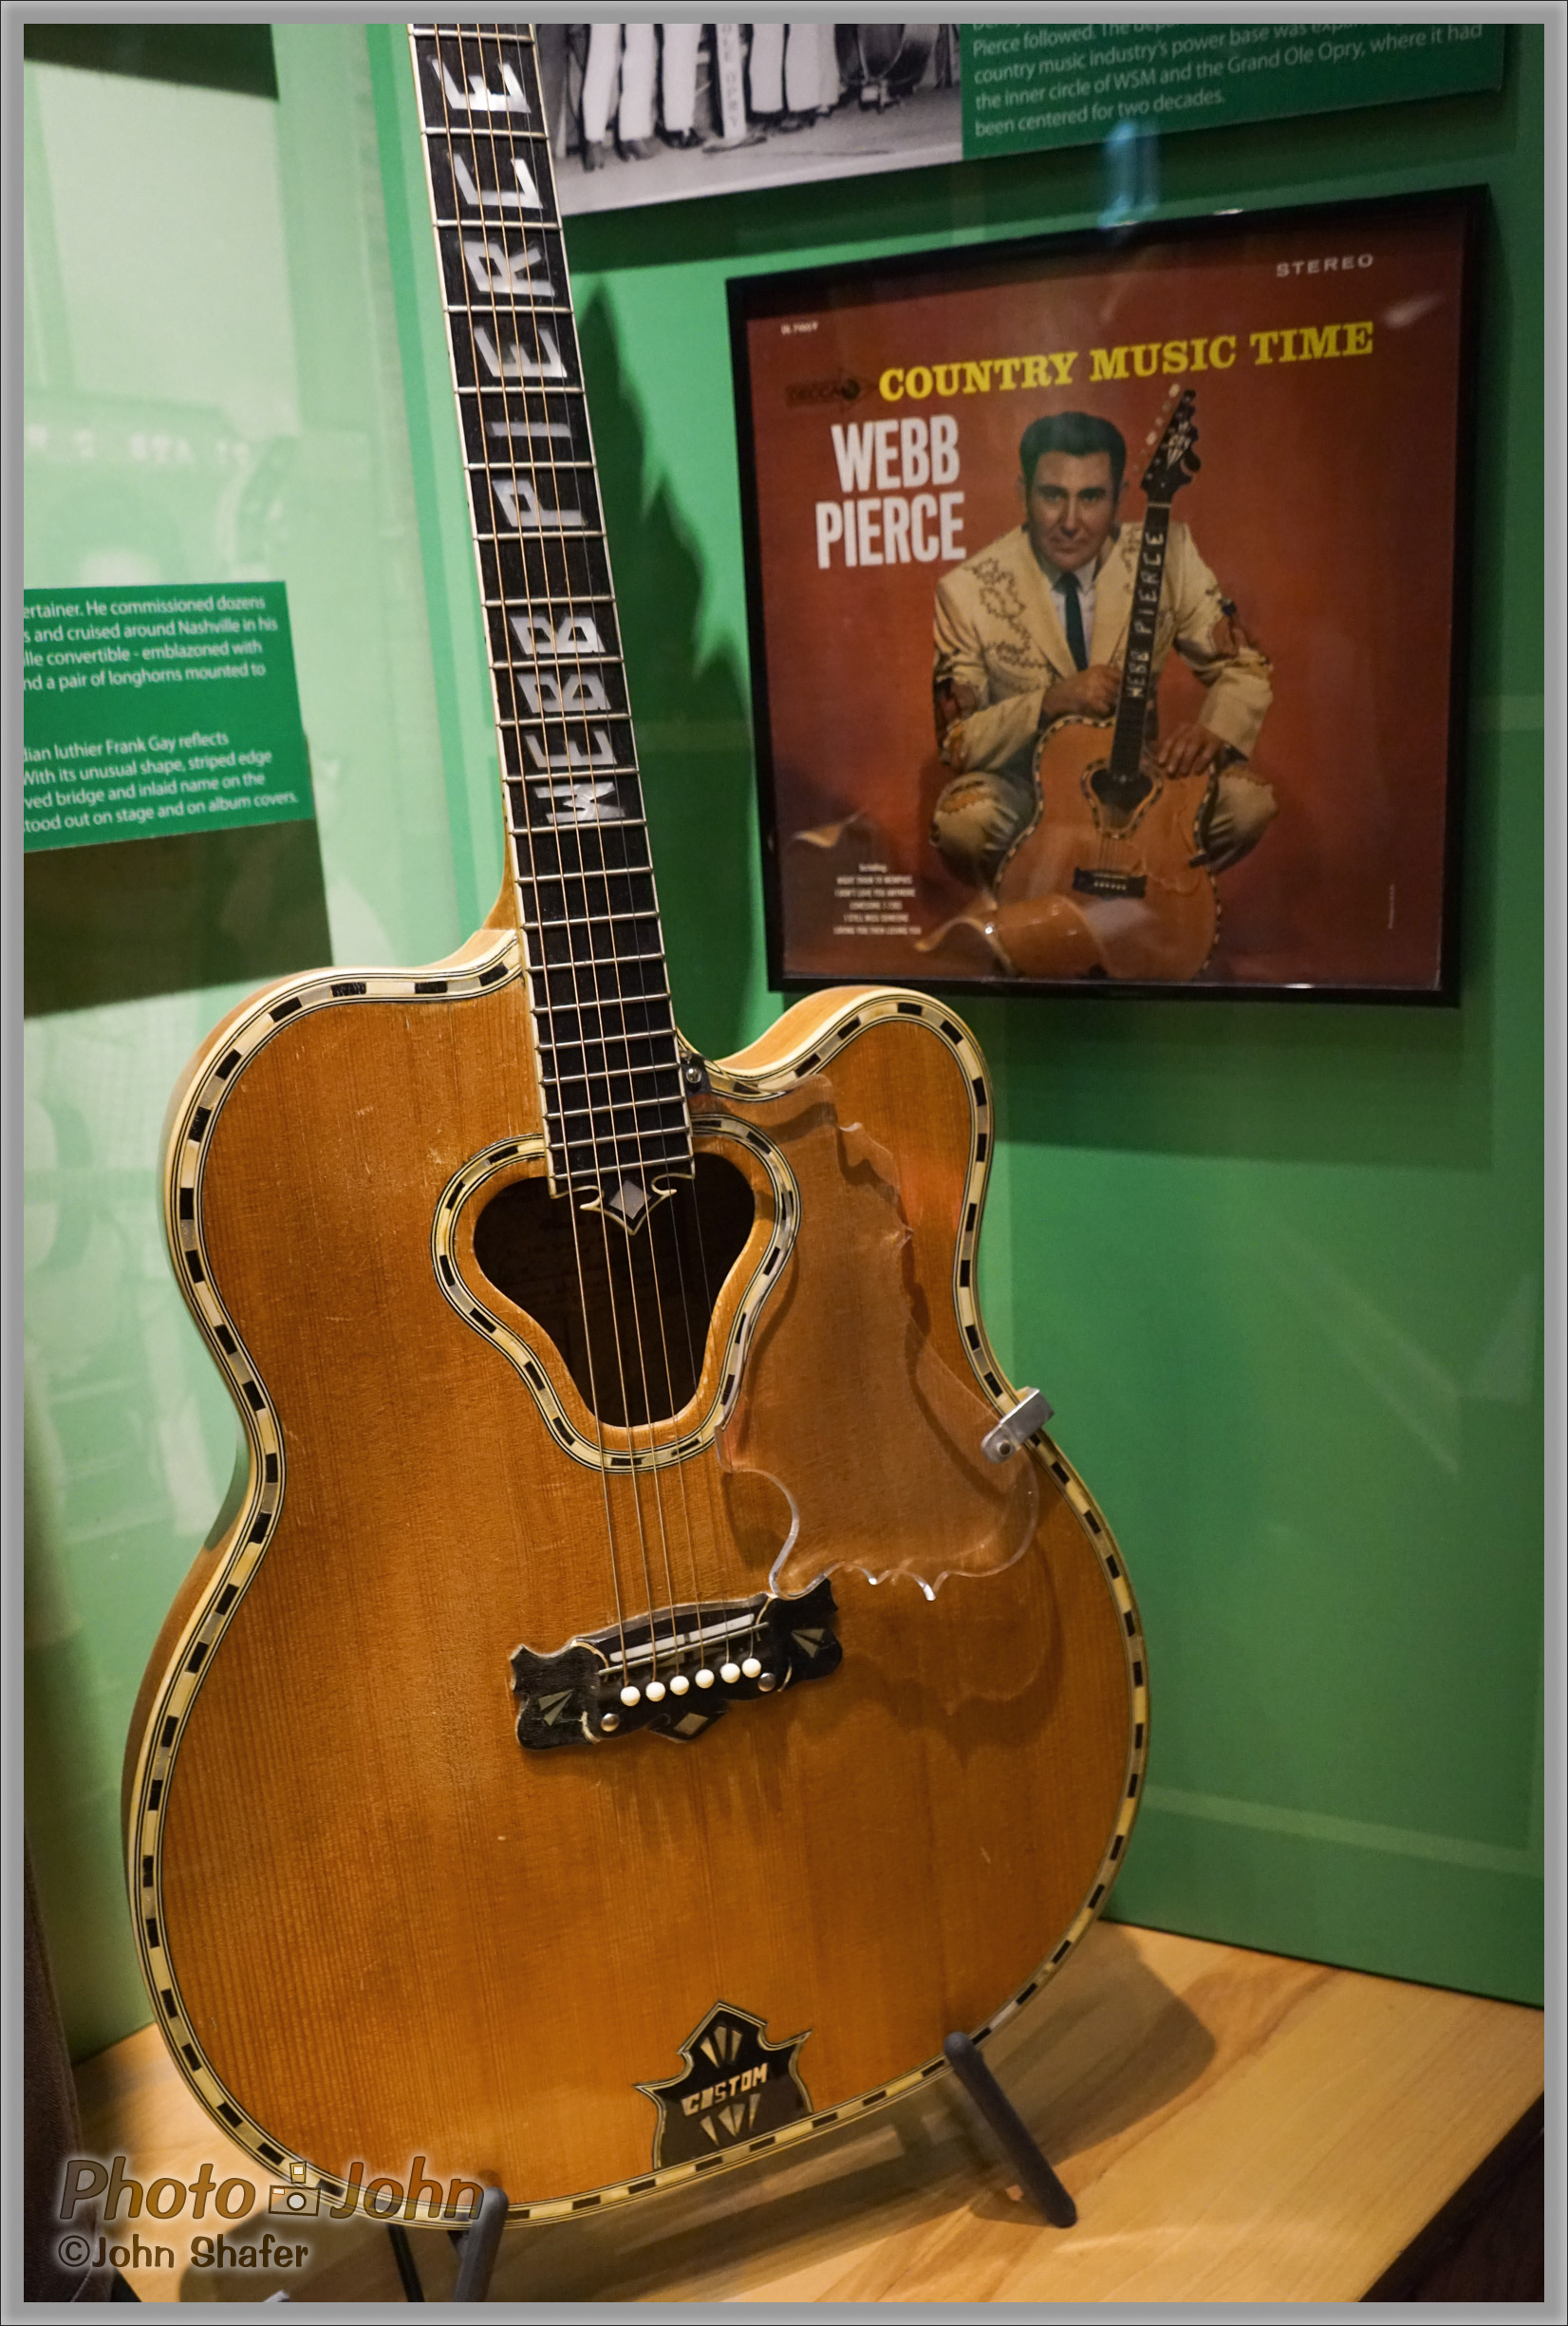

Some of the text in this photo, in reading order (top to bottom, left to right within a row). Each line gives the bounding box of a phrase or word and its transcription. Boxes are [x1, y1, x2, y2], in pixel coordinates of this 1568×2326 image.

[973, 37, 1020, 58] Pierce
[1023, 26, 1096, 50] followed.
[974, 63, 1036, 85] country
[1038, 51, 1086, 74] music
[1090, 37, 1168, 67] industry's
[1171, 33, 1226, 59] power
[1229, 28, 1270, 47] base
[1273, 24, 1307, 39] was
[976, 24, 1484, 110] the inner circle of WSM and the Grand Ole Opry, where it had
[975, 87, 1225, 138] been centered for two decades.
[1277, 253, 1374, 278] STEREO
[879, 322, 1374, 403] COUNTRY MUSIC TIME
[426, 54, 625, 824] WEBB PIERCE
[831, 413, 961, 493] WEBB
[814, 492, 966, 570] PIERCE
[24, 594, 266, 618] ertainer. He commissioned dozens
[34, 625, 65, 642] and
[66, 623, 121, 641] cruised
[123, 620, 176, 638] around
[178, 617, 240, 634] Nashville
[243, 619, 256, 631] in
[258, 615, 278, 631] his
[47, 646, 131, 665] convertible
[141, 641, 230, 661] emblazoned
[232, 639, 263, 654] with
[47, 676, 56, 689] a
[59, 673, 87, 692] pair
[90, 669, 105, 686] of
[108, 666, 183, 687] longhorns
[185, 661, 250, 680] mounted
[251, 664, 267, 677] to
[54, 742, 103, 760] luthier
[105, 736, 146, 756] Frank
[148, 735, 177, 754] Gay
[178, 730, 230, 748] reflects
[59, 768, 77, 782] its
[80, 760, 137, 780] unusual
[140, 759, 186, 777] shape,
[188, 751, 236, 771] striped
[237, 749, 272, 767] edge
[55, 788, 105, 807] bridge
[107, 784, 136, 800] and
[139, 779, 177, 797] inlaid
[179, 778, 219, 794] name
[221, 776, 241, 789] on
[242, 771, 266, 787] the
[24, 791, 298, 833] tood out on stage and on album covers.
